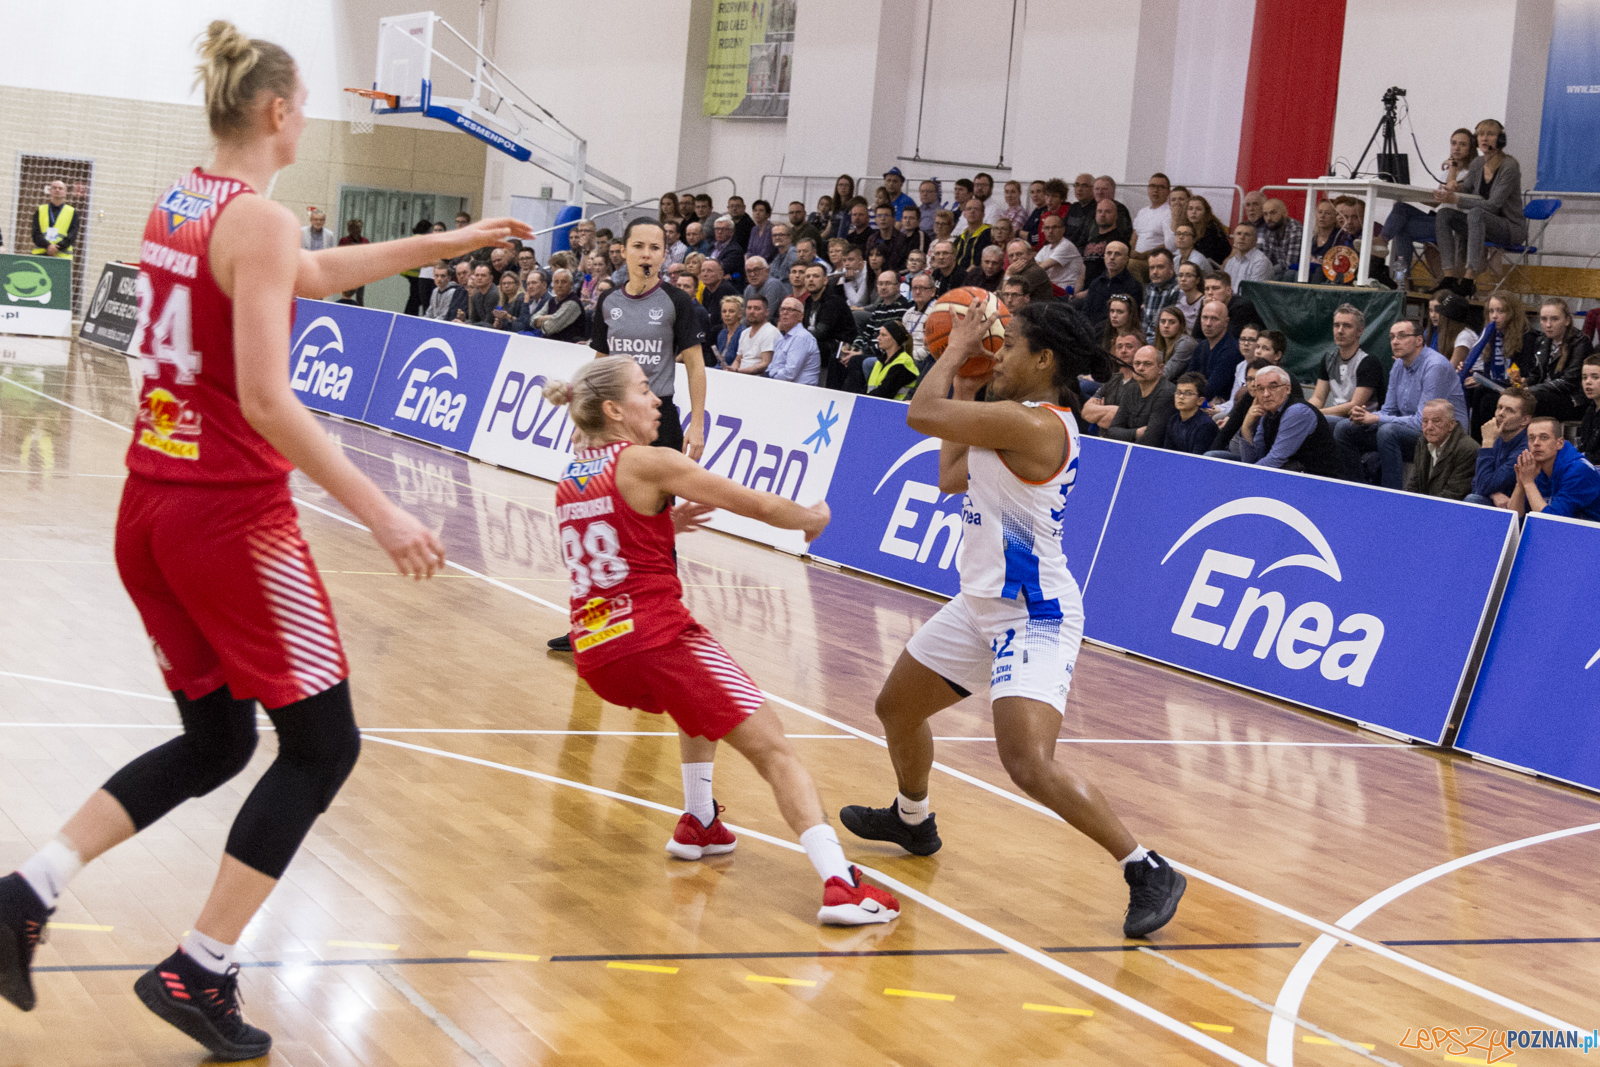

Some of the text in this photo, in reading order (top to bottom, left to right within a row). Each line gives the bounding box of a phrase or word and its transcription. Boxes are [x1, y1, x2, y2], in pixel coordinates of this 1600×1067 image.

[457, 116, 517, 152] PESMENPOL
[290, 344, 353, 401] Enea
[395, 368, 467, 432] Enea
[962, 508, 982, 526] nea
[561, 520, 630, 599] 88
[1171, 549, 1385, 688] Enea
